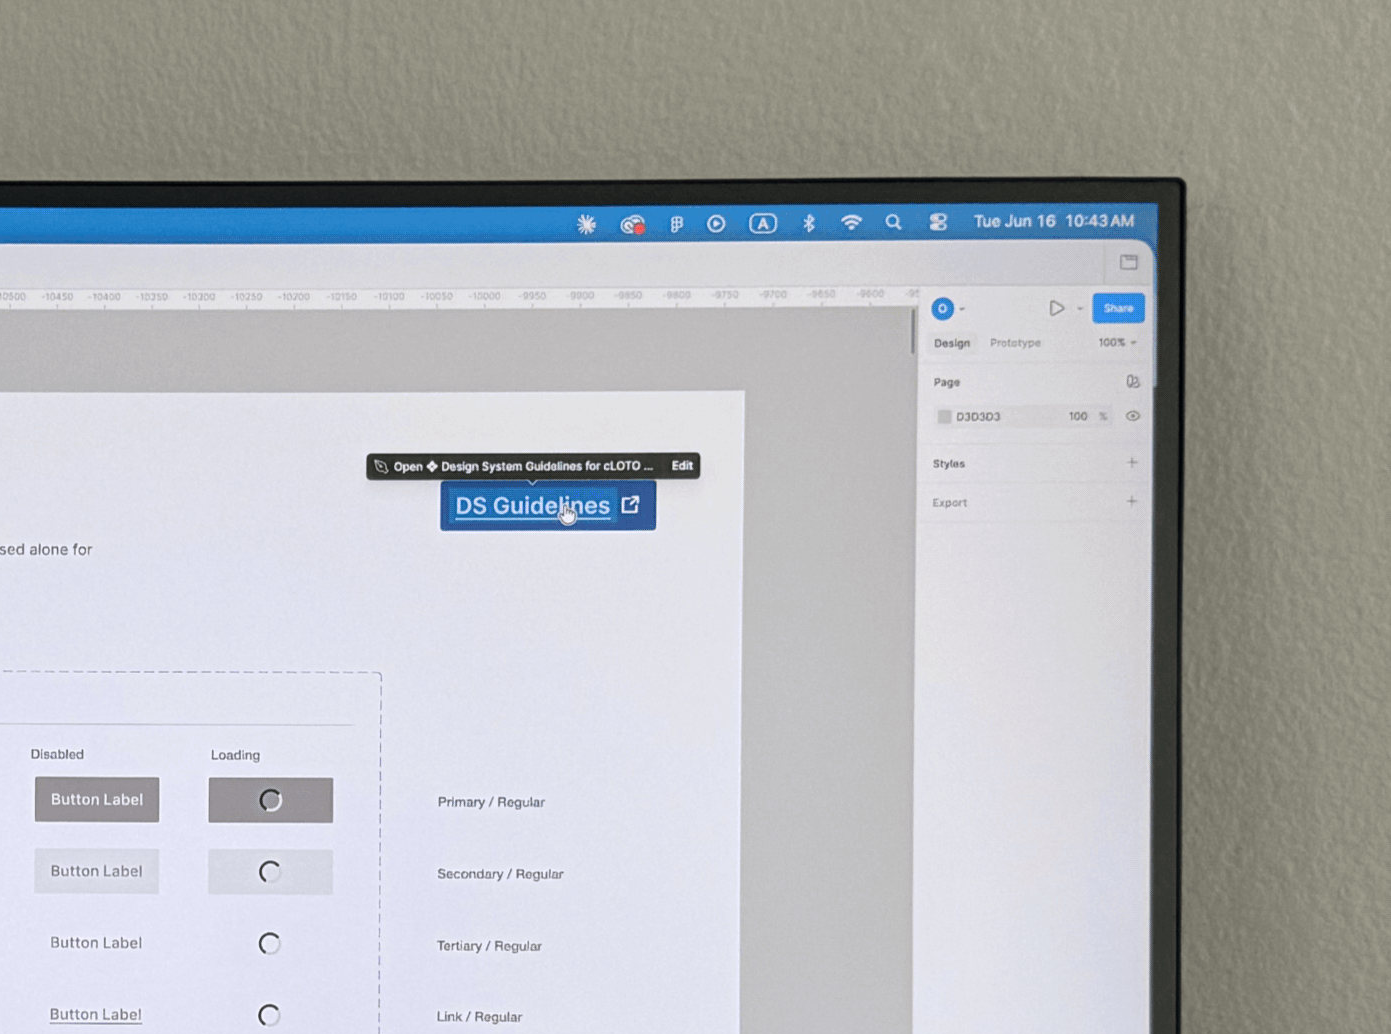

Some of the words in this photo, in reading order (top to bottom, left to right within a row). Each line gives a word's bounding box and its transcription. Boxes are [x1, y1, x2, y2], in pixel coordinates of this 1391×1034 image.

[974, 214, 1001, 228] Tue
[1005, 214, 1032, 227] Jun
[1037, 214, 1056, 228] 16
[1066, 214, 1108, 227] 10:43
[1110, 214, 1135, 227] AM
[1104, 303, 1134, 312] Share
[935, 339, 970, 350] Design
[991, 338, 1041, 349] Prototype
[1099, 338, 1125, 347] 100%
[934, 378, 960, 389] Page
[957, 412, 1000, 421] D3D3D3
[394, 462, 423, 473] Open
[442, 461, 479, 474] Design
[482, 461, 522, 473] System
[526, 461, 582, 471] Guidelines
[585, 461, 601, 471] for
[604, 461, 641, 471] cLOTO
[672, 461, 693, 470] Edit
[933, 459, 965, 470] Styles
[456, 497, 486, 514] DS
[494, 496, 610, 515] Guidelines
[30, 544, 68, 555] alone
[73, 543, 92, 555] for
[31, 749, 84, 759] Disabled
[212, 750, 260, 763] Loading
[439, 797, 485, 809] Primary
[498, 797, 545, 810] Regular
[437, 1011, 462, 1022] Link
[475, 1011, 523, 1025] Regular
